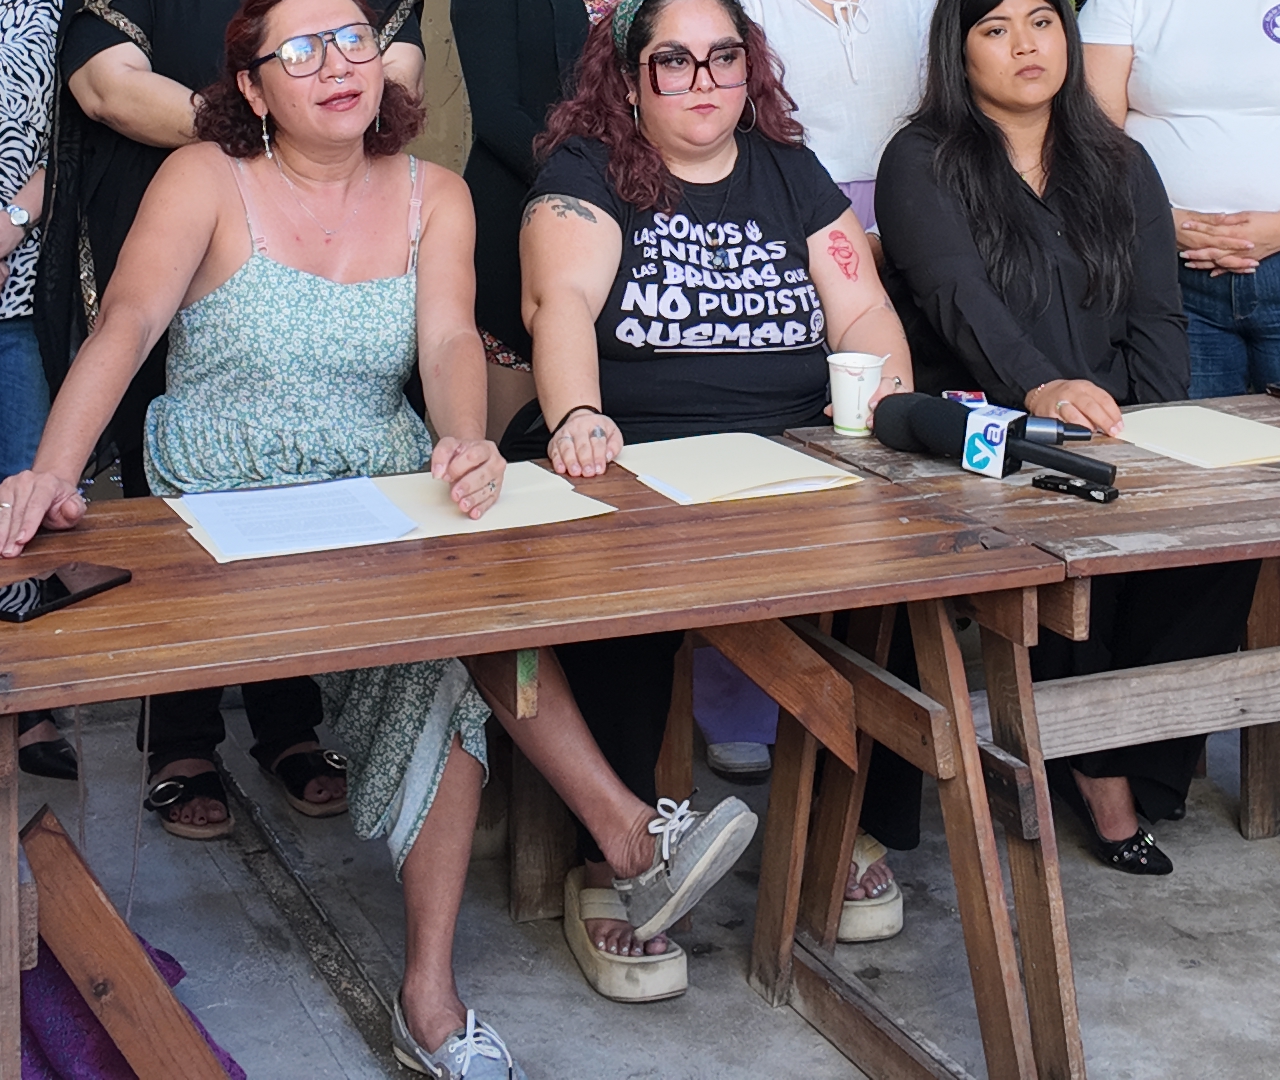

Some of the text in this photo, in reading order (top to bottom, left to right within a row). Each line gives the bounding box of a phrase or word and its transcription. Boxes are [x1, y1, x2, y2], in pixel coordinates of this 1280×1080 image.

[633, 227, 658, 246] LAS
[643, 247, 658, 260] DE
[632, 261, 809, 290] LAS BRUJAS QUE
[621, 281, 820, 320] NO PUDISTE
[615, 317, 807, 348] QUEMAR
